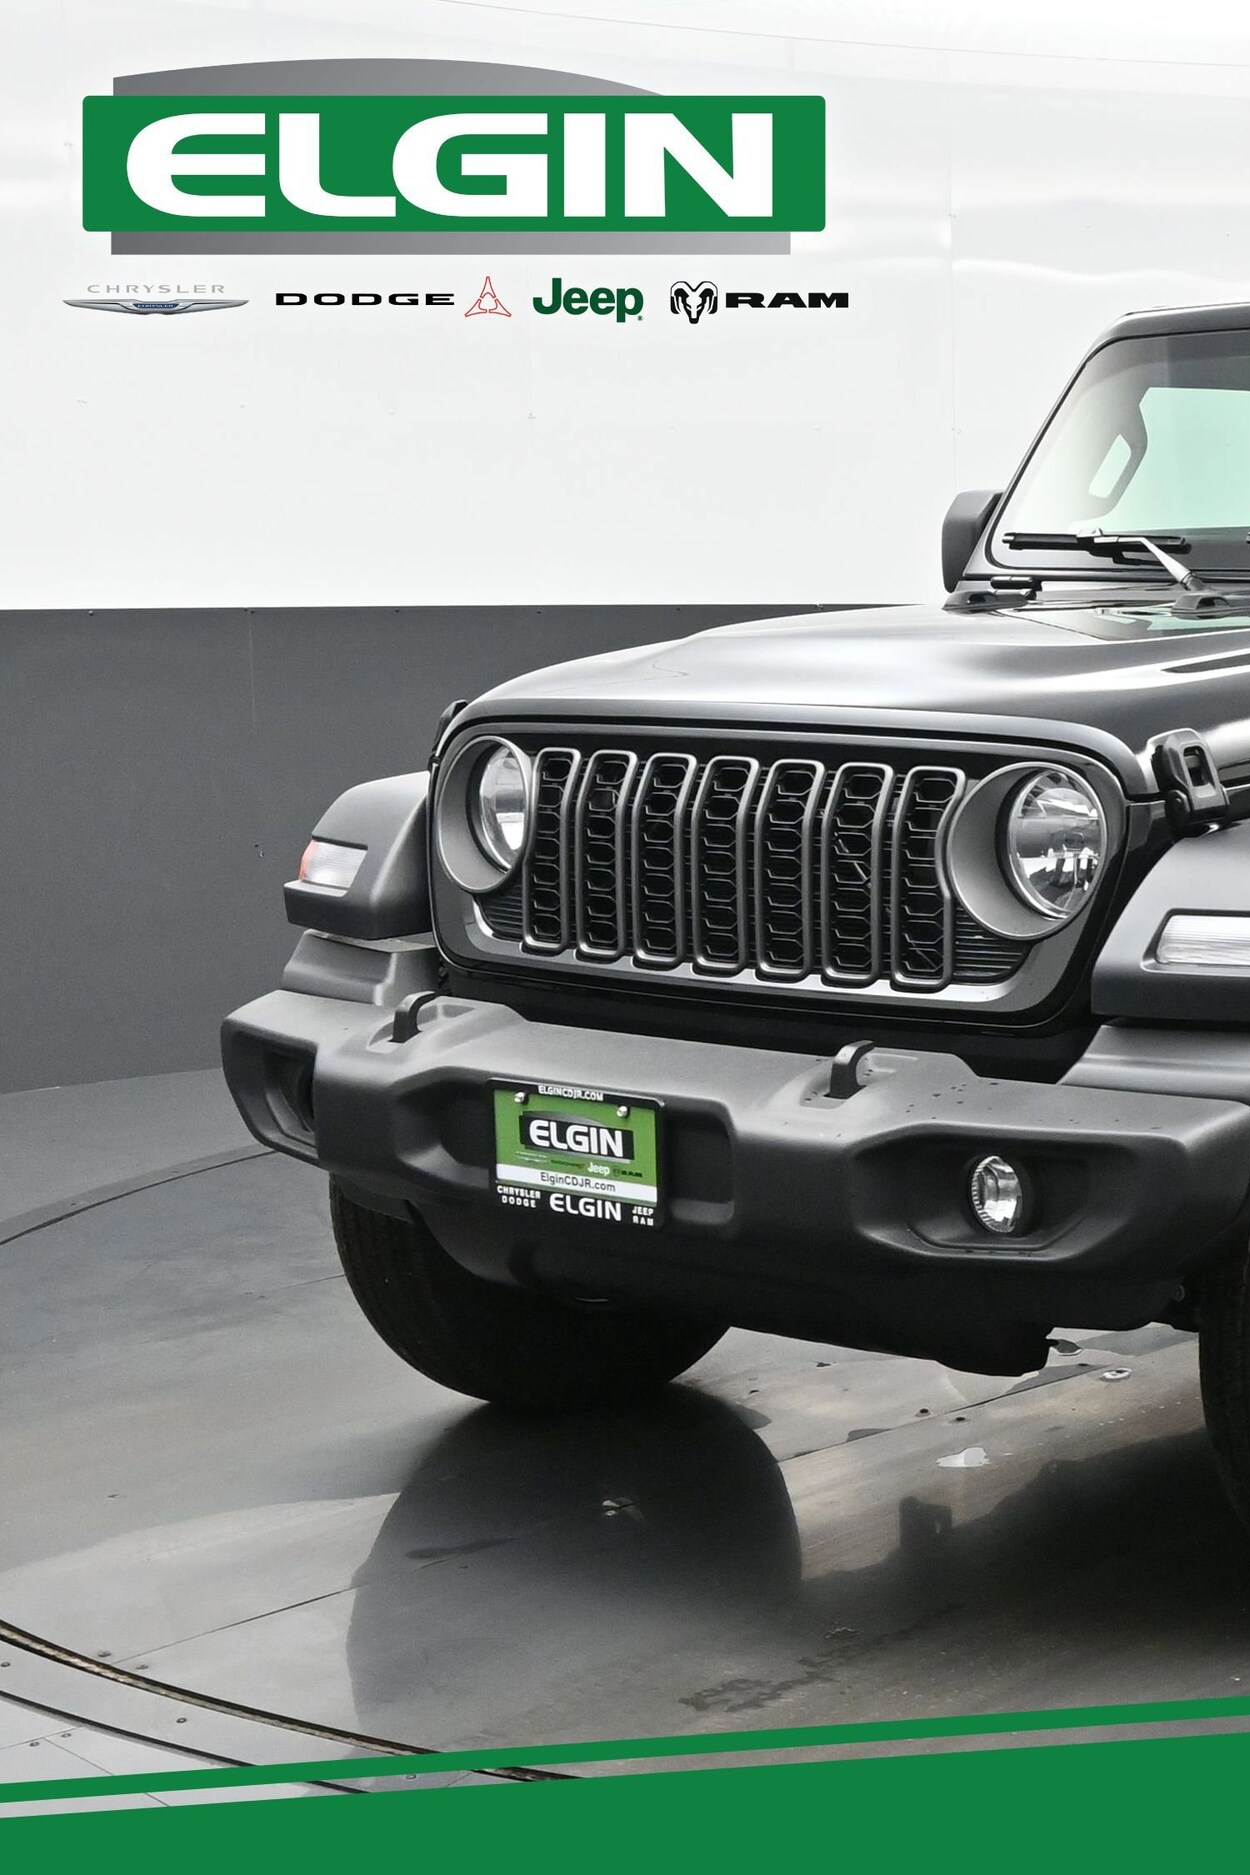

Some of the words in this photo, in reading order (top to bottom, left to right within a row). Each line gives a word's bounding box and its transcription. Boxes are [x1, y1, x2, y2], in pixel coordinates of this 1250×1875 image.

[538, 1085, 604, 1101] ELGINCDJR.COM
[529, 1119, 624, 1158] ELGIN
[587, 1162, 610, 1176] Jeep
[540, 1172, 616, 1192] ElginCDJR.com
[497, 1185, 541, 1200] CHRYSLER
[502, 1195, 537, 1208] DODGE
[549, 1193, 622, 1221] ELGIN
[632, 1206, 654, 1216] JEEP
[632, 1215, 654, 1226] RAM
